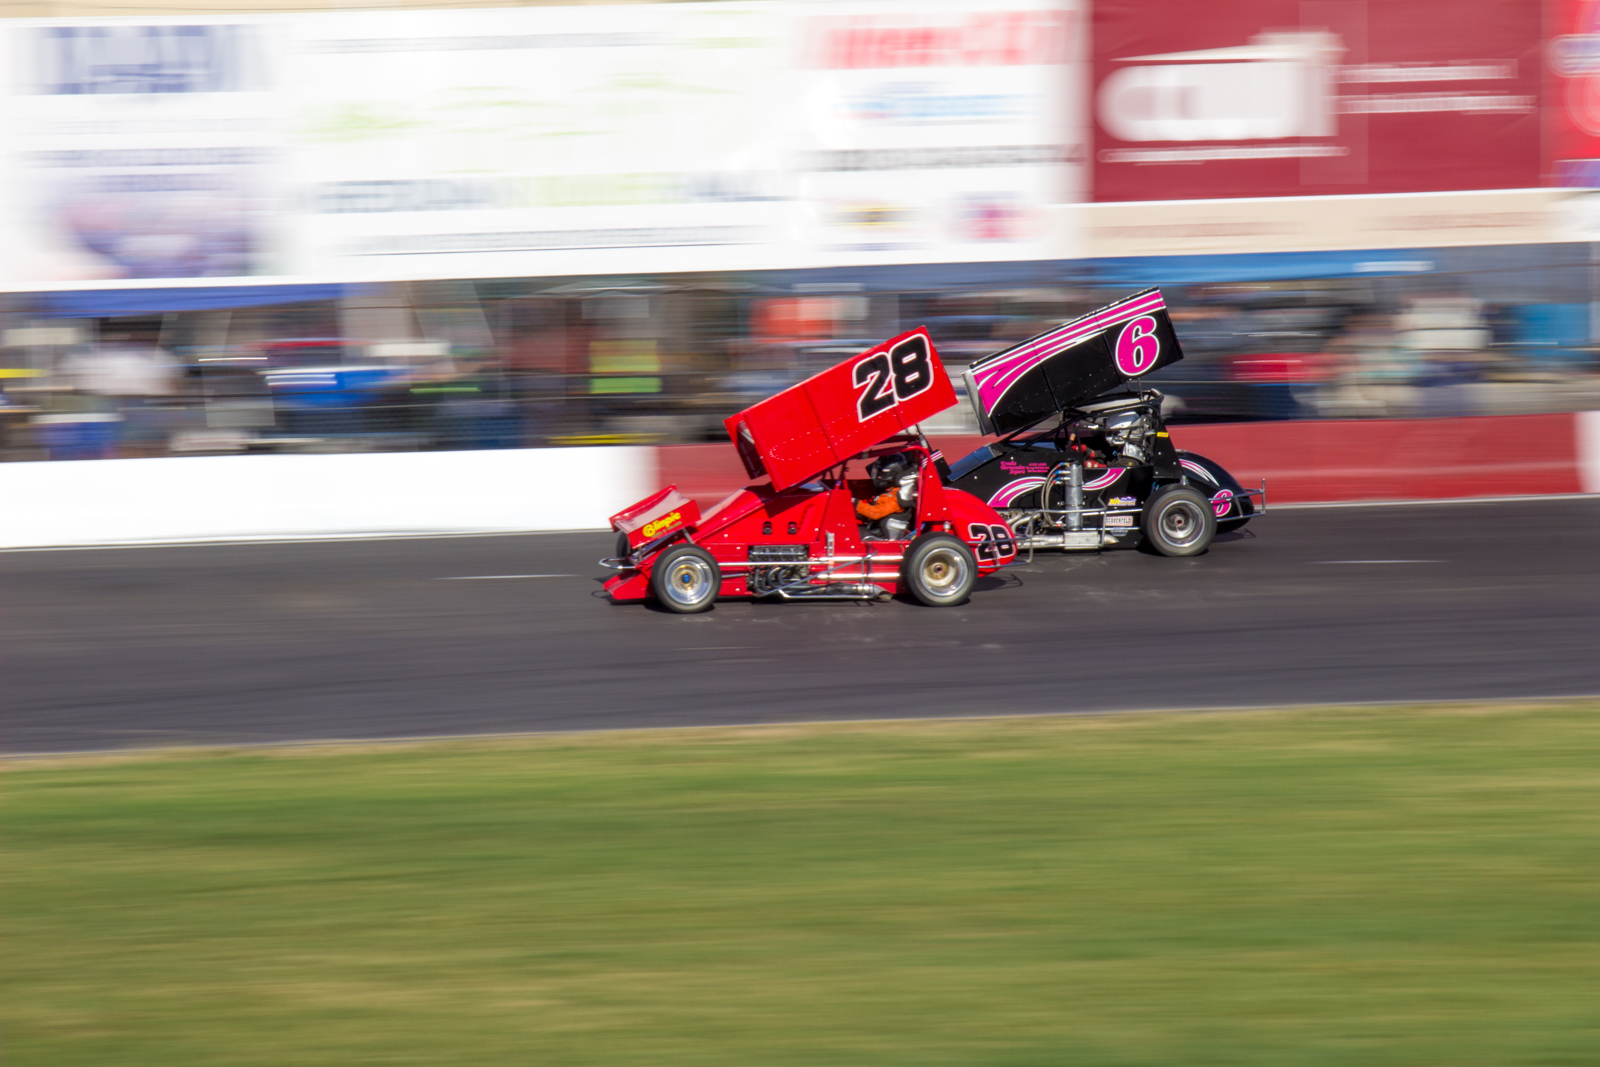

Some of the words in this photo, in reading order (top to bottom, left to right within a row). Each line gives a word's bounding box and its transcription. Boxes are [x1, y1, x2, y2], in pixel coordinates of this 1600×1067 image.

[1115, 315, 1160, 376] 6
[852, 333, 934, 423] 28
[1210, 489, 1233, 517] 6
[968, 523, 1016, 562] 28
